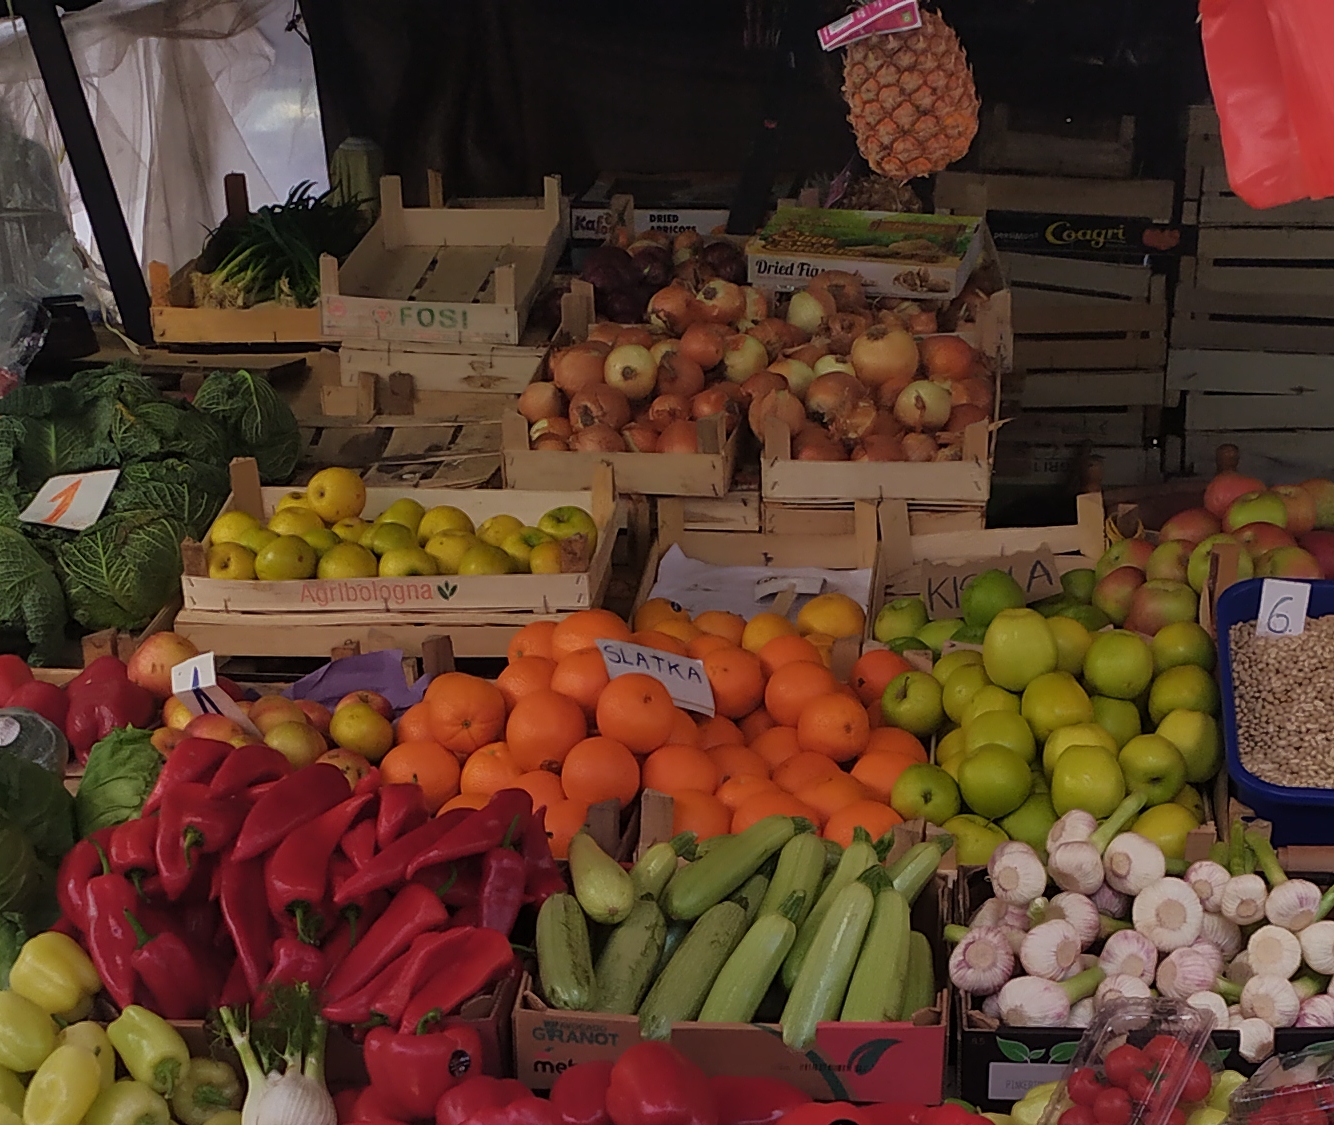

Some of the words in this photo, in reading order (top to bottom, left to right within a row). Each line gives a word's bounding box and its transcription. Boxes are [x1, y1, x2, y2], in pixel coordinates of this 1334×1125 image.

[649, 214, 679, 224] DRIED
[1044, 221, 1127, 249] Coagri
[756, 259, 794, 276] Dried
[299, 582, 434, 605] Agribologna
[604, 645, 704, 685] SLATKA
[532, 1028, 619, 1047] GRANOT
